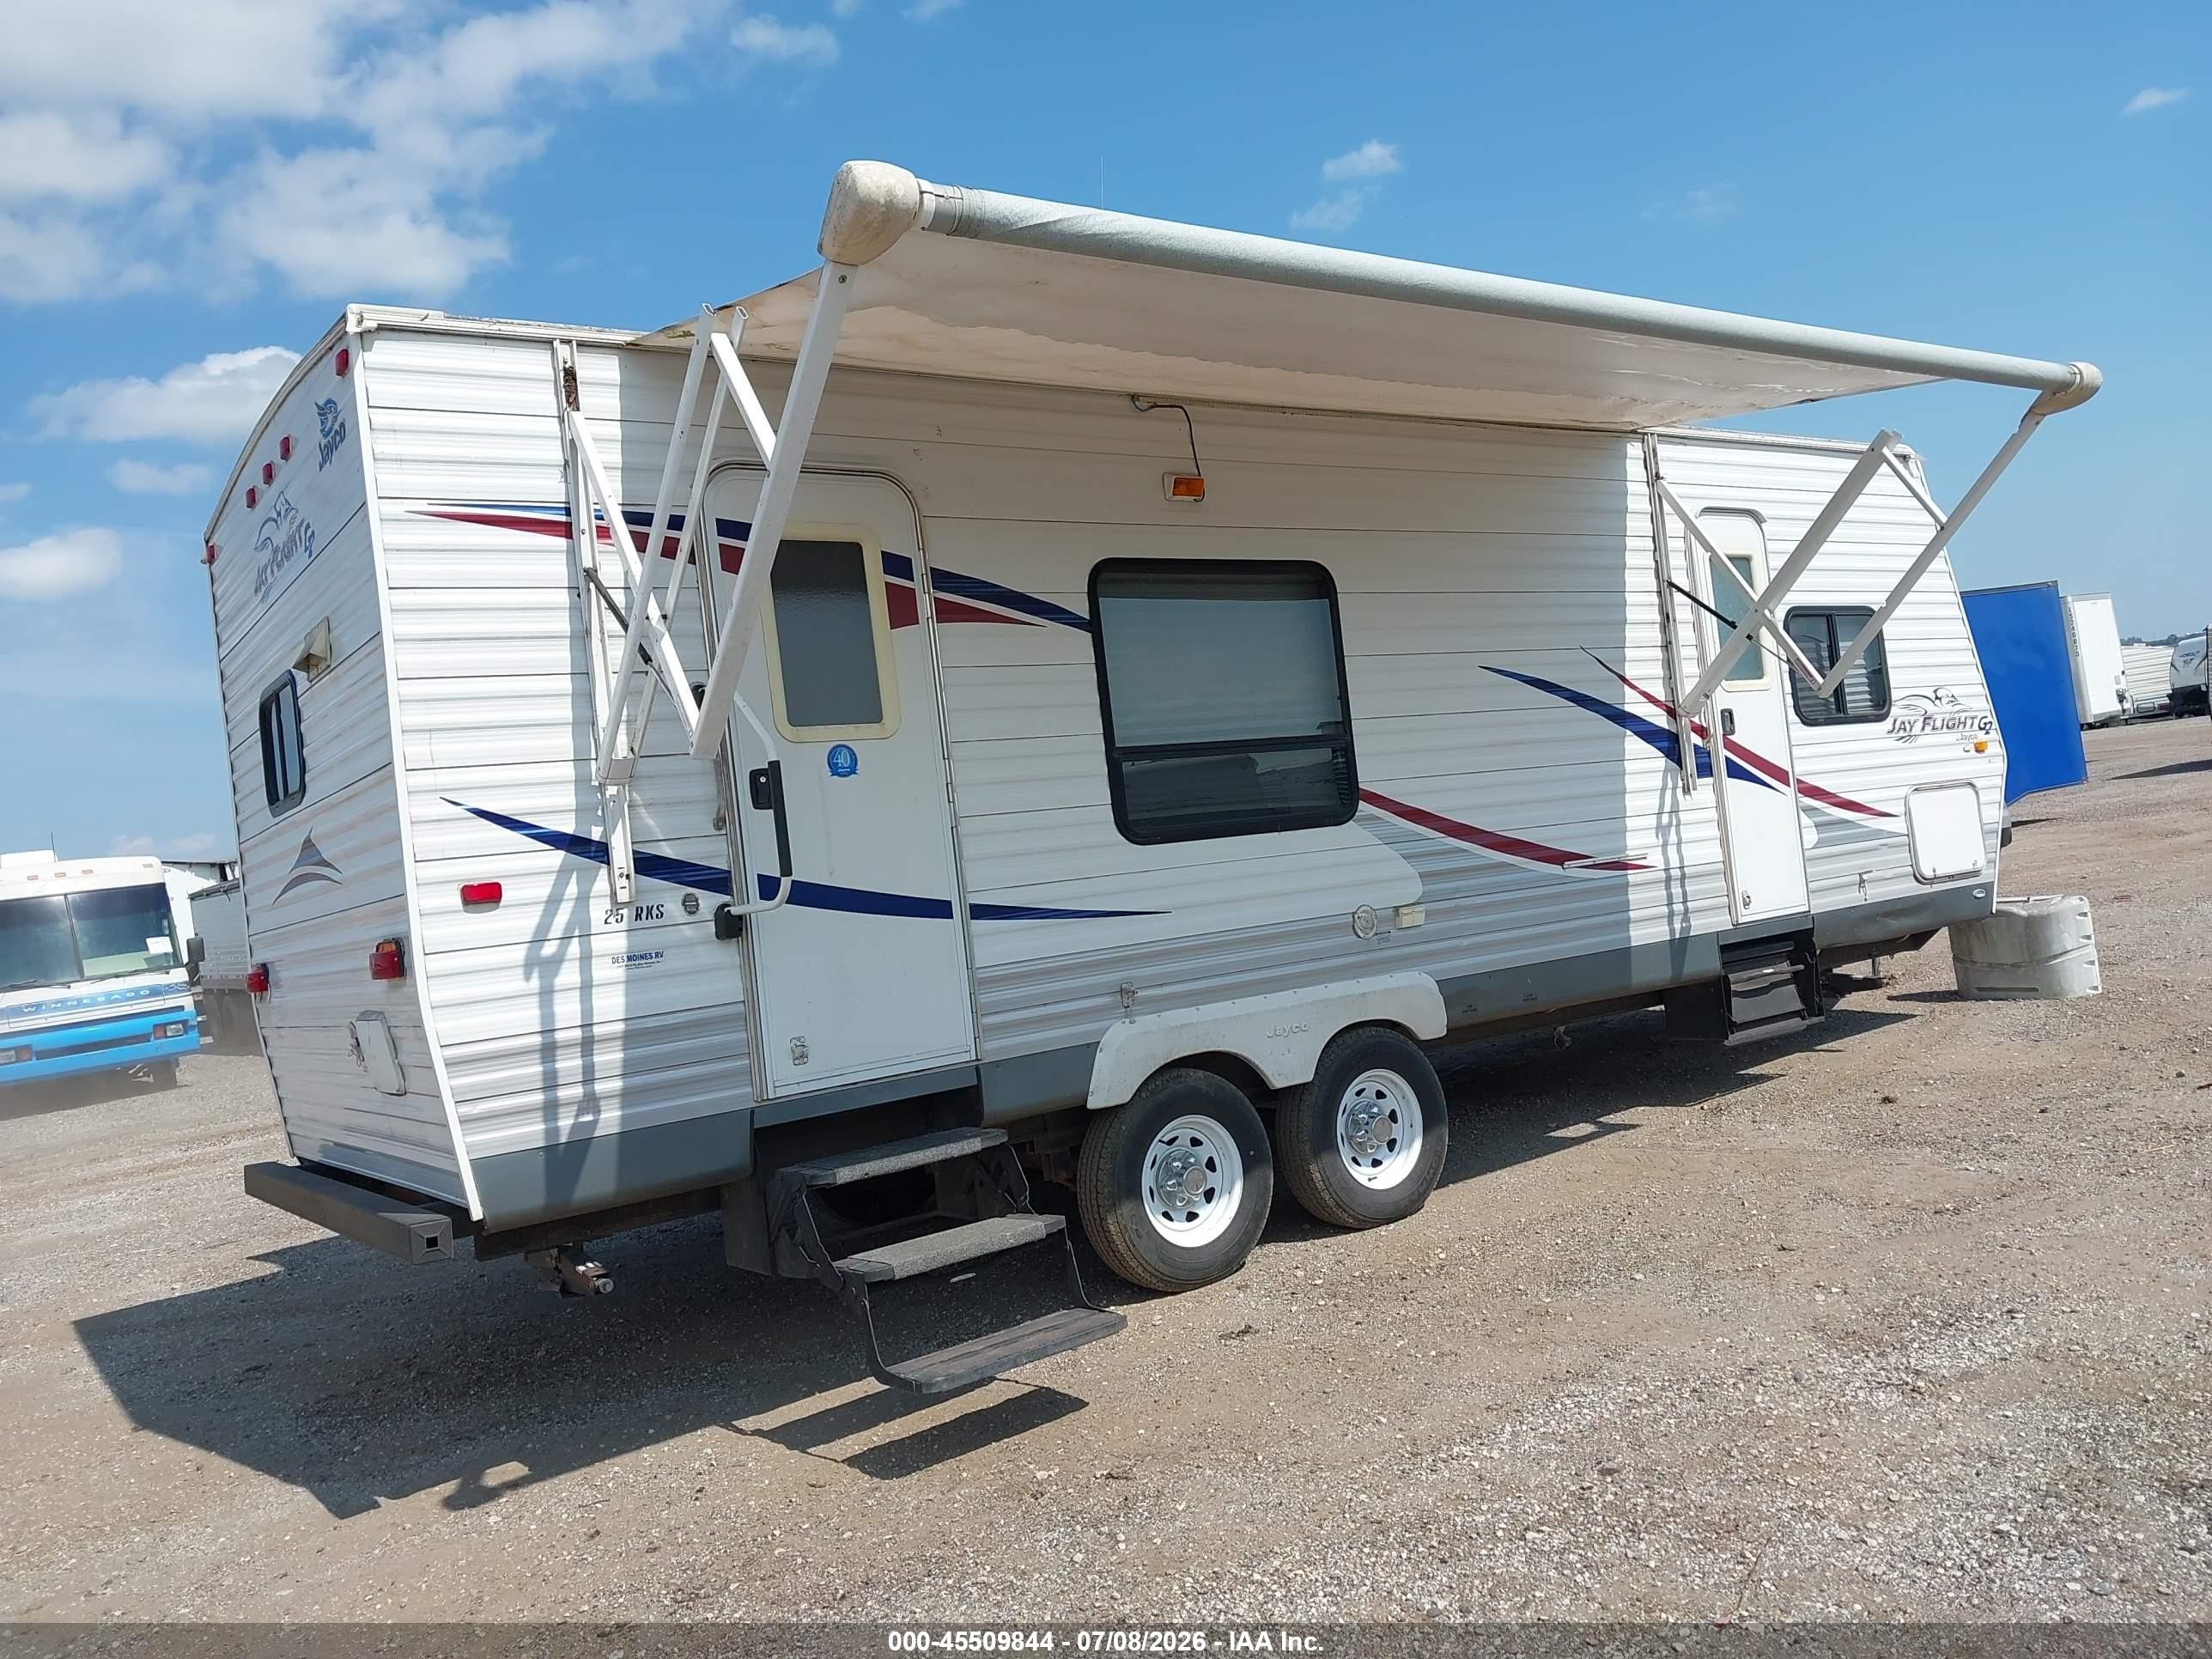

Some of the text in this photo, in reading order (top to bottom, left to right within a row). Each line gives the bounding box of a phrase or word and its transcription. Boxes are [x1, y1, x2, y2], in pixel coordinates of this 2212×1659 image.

[319, 420, 346, 472] Jayco
[1887, 714, 1994, 735] JAY FLIGHT G2
[1960, 732, 1978, 742] Jayco
[833, 749, 851, 767] 40
[604, 903, 665, 925] 25 RKS
[611, 955, 625, 964] DES
[627, 952, 653, 963] MOINES
[654, 951, 664, 959] RV
[1266, 1022, 1310, 1040] Jayco
